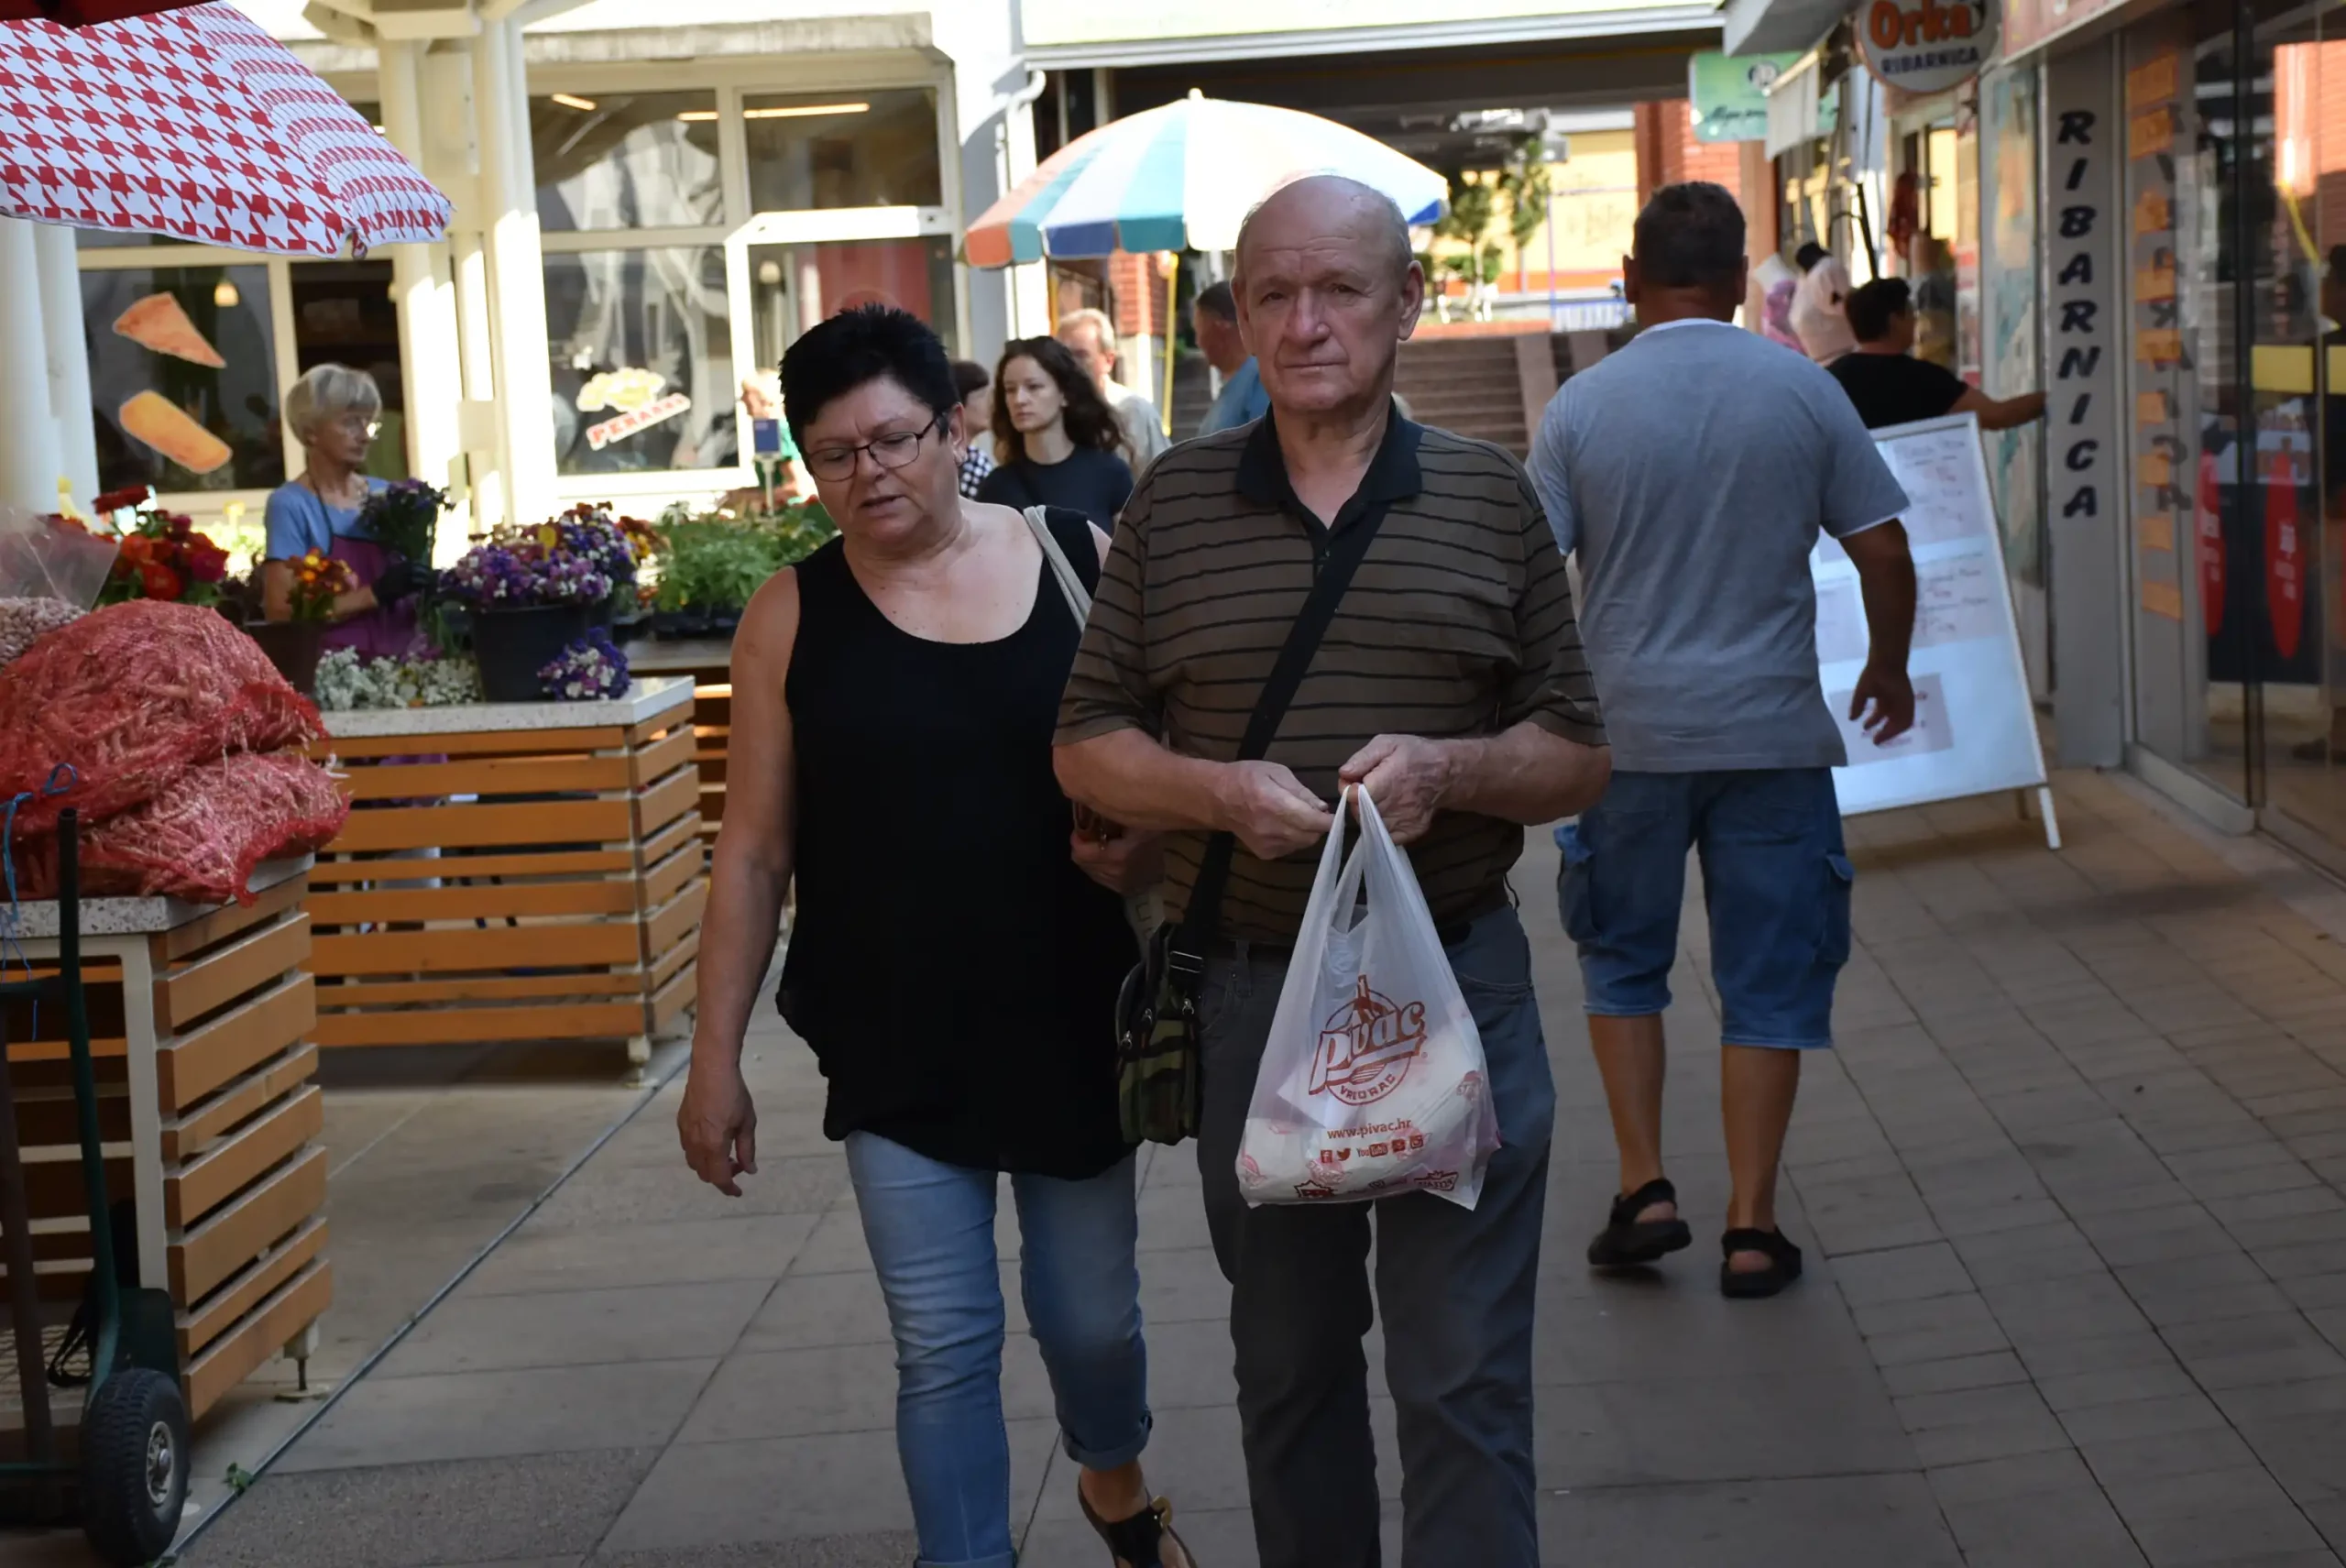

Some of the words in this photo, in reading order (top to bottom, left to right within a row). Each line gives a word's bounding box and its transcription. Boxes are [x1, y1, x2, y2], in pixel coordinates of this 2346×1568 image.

[1869, 0, 1971, 49] Orka
[1881, 46, 1980, 76] RIBARNICA
[2056, 110, 2100, 519] RIBARNICA
[1327, 1119, 1412, 1139] www.pivac.hr
